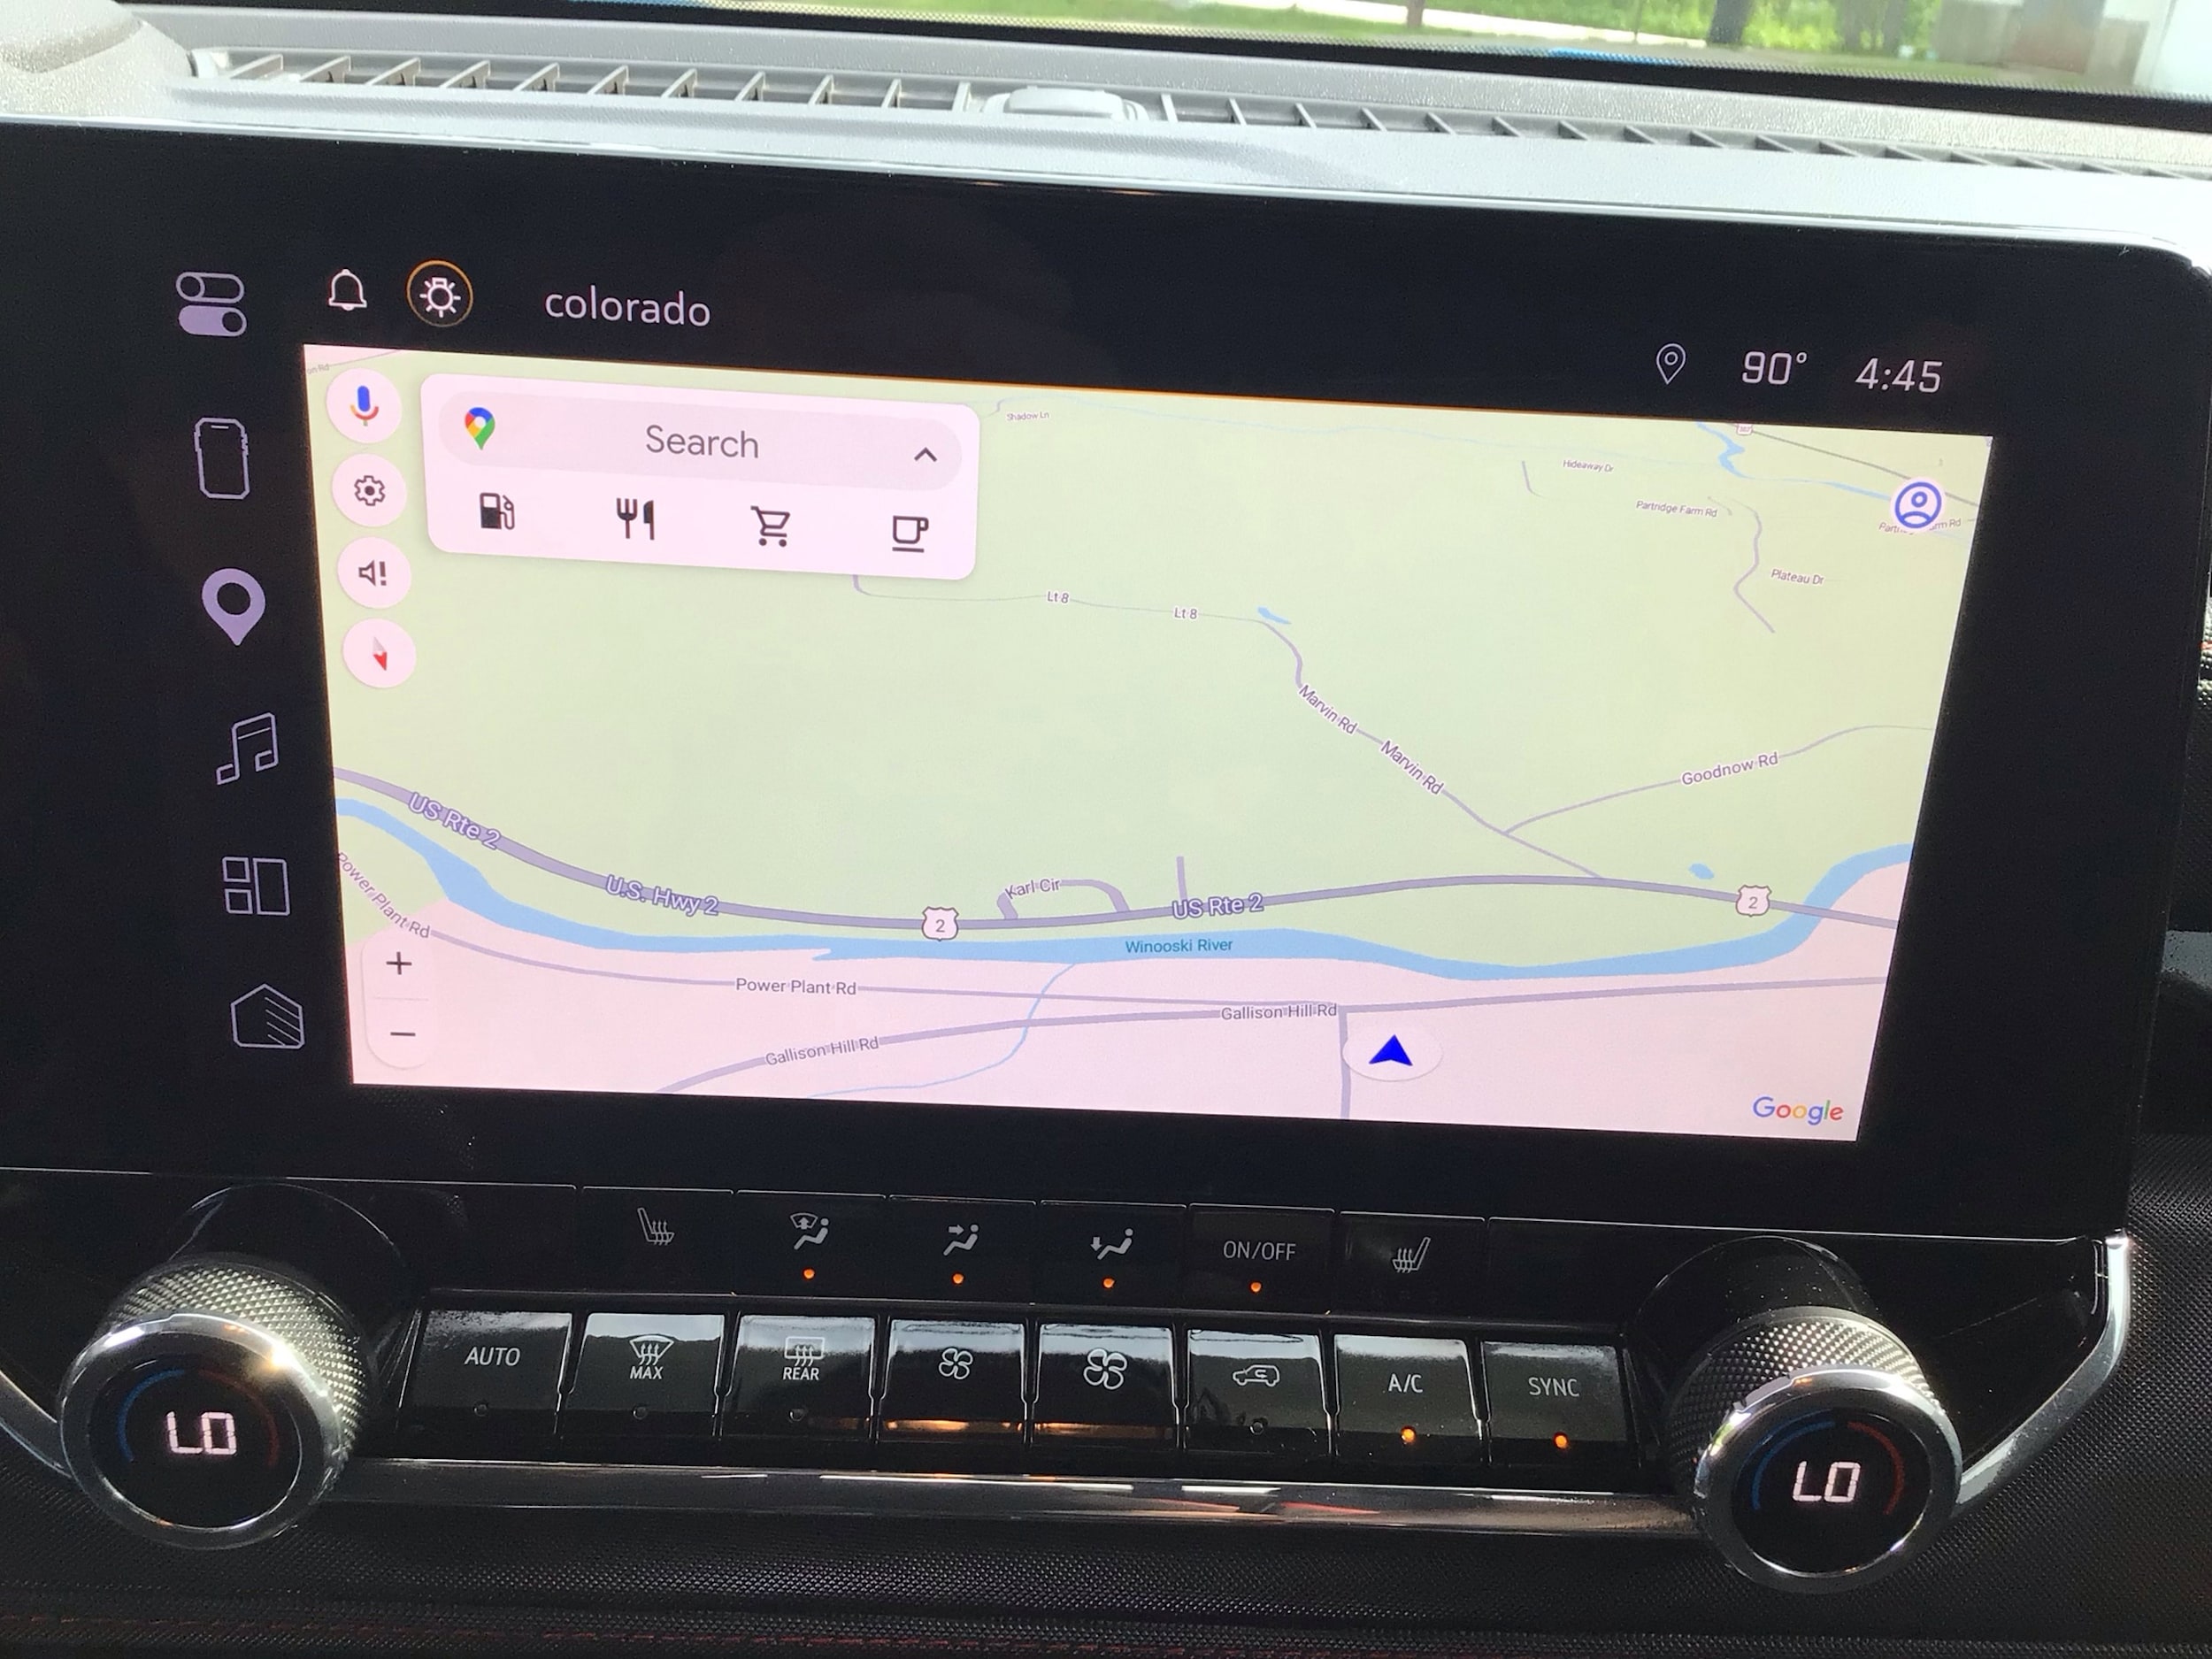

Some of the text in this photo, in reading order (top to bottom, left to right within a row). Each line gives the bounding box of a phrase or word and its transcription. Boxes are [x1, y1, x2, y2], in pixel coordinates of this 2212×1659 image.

[544, 285, 711, 326] colorado
[1741, 350, 1808, 385] 90°
[1855, 357, 1944, 393] 4:45
[1006, 412, 1039, 421] Shadow
[645, 424, 760, 459] Search
[1563, 459, 1603, 472] Hideaway
[1636, 500, 1717, 518] Partridge Farm Rd
[1948, 518, 1962, 528] Rd
[1770, 568, 1824, 586] Plateau Dr
[1047, 591, 1069, 604] Lt 8
[1173, 607, 1197, 620] Lt 8
[1298, 685, 1358, 734] Marvin Rd
[1380, 740, 1444, 795] Marvin Rd
[1681, 751, 1778, 787] Goodnow Rd
[409, 792, 501, 850] US Rte 2
[338, 851, 431, 939] Power Plant Rd
[605, 873, 718, 917] U.S. Hwy 2
[1006, 877, 1061, 901] Karl Cir
[1171, 892, 1264, 919] US Rte 2
[1748, 895, 1758, 910] 2
[935, 919, 946, 933] 2
[1125, 937, 1233, 954] Winooski River
[735, 978, 856, 995] Power Plant Rd
[1221, 1002, 1337, 1020] Gallison Hill Rd
[765, 1035, 879, 1066] Gallison Hill Rd
[1752, 1095, 1843, 1125] Google
[1222, 1240, 1296, 1262] ON/OFF
[464, 1347, 520, 1368] AUTO
[629, 1364, 664, 1380] MAX
[781, 1366, 820, 1382] REAR
[1387, 1372, 1424, 1394] A/C
[1528, 1376, 1579, 1398] SYNC
